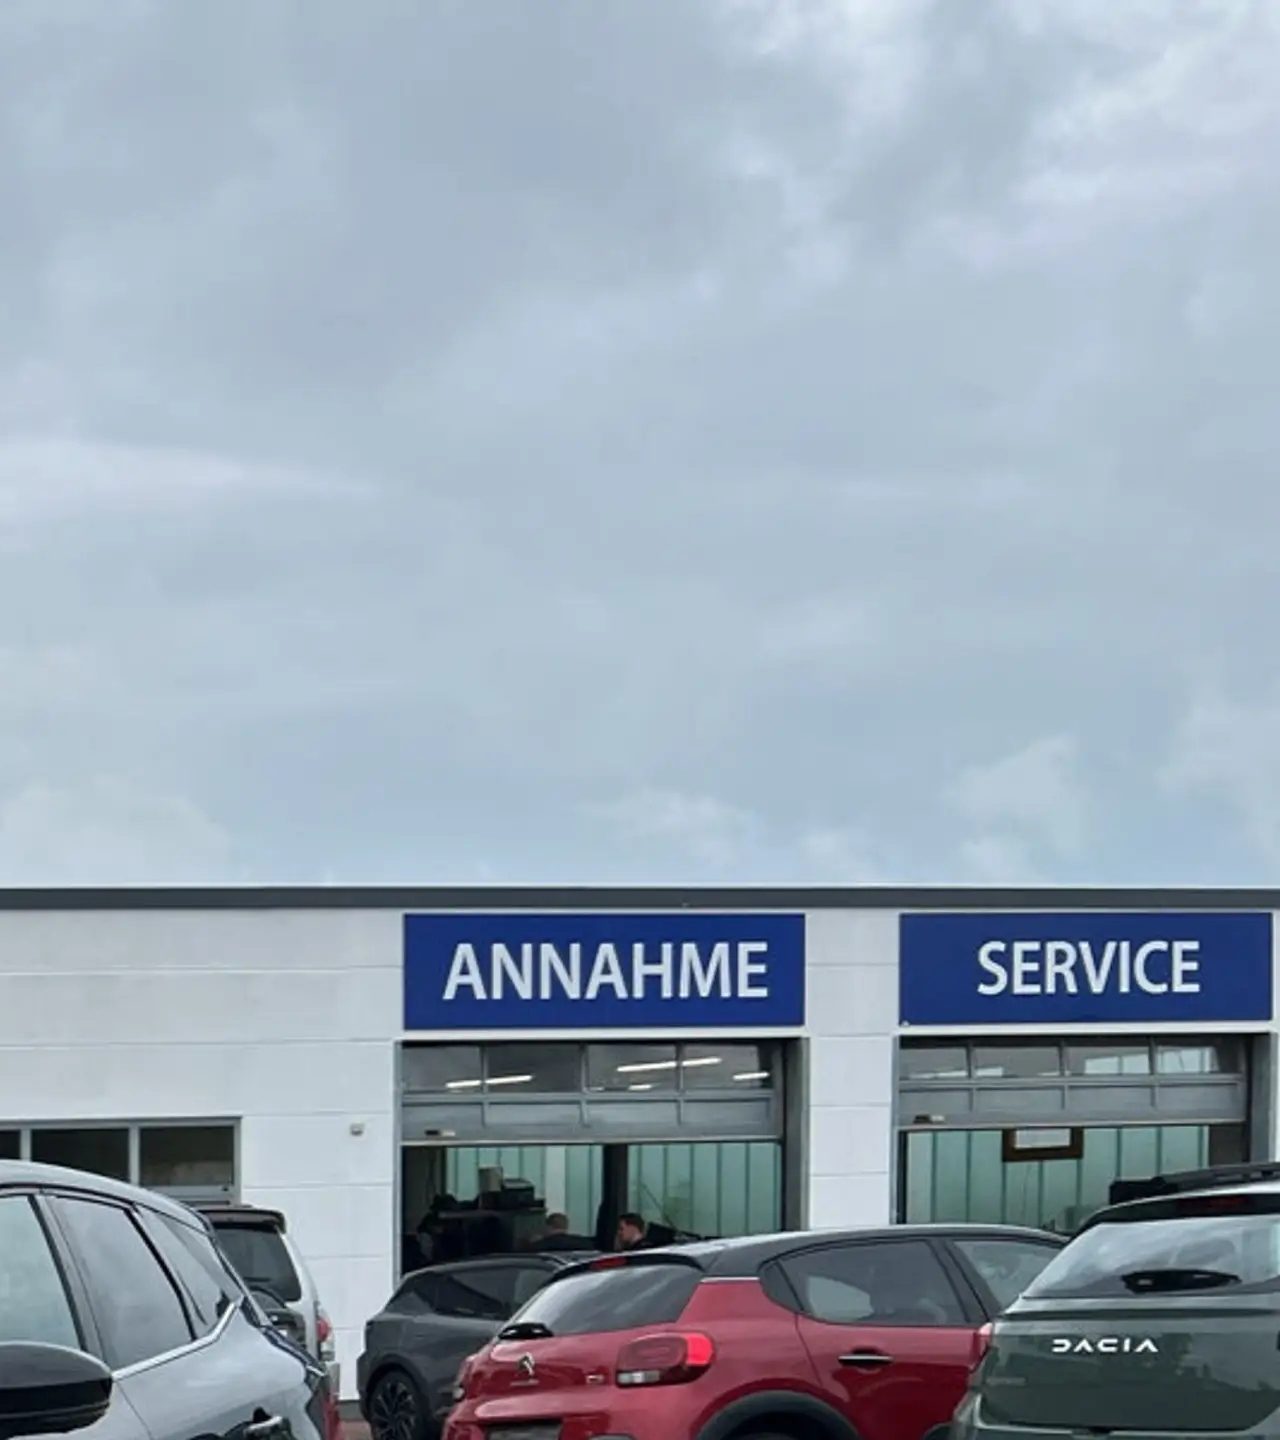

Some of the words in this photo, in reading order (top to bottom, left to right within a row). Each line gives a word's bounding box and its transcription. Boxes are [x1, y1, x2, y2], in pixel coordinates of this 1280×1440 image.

[442, 941, 768, 1000] ANNAHME
[977, 940, 1200, 995] SERVICE
[1052, 1338, 1158, 1353] DACIA
